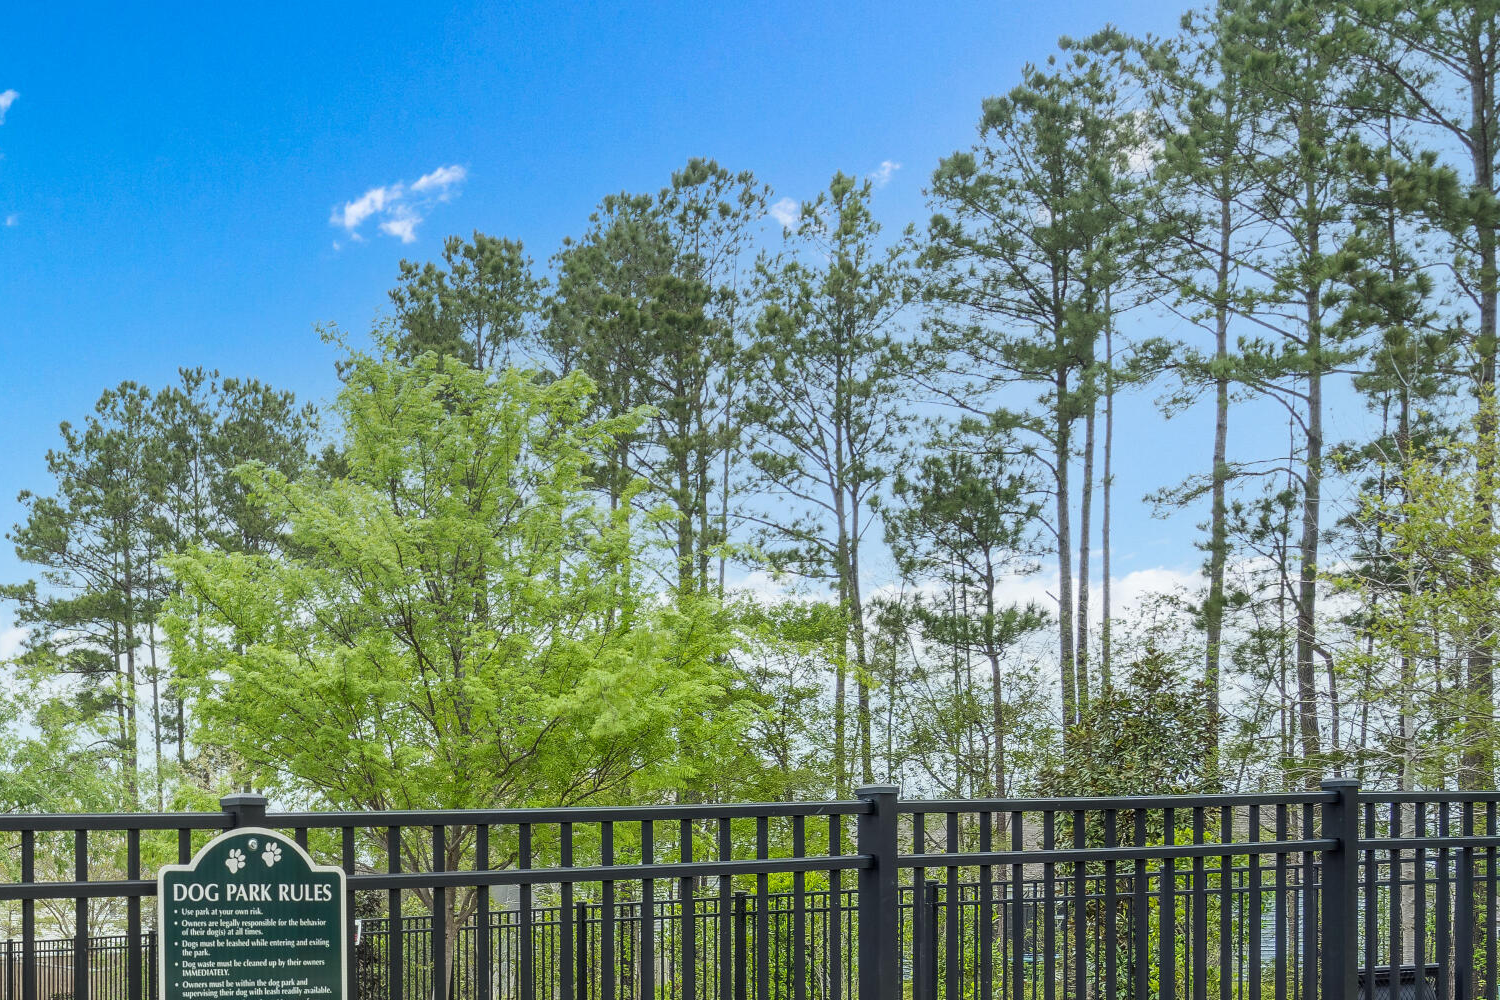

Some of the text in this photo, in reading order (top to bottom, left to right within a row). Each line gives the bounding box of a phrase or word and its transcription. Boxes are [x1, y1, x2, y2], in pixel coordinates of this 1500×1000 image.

[173, 883, 332, 902] DOG PARK RULES
[182, 908, 195, 916] Use
[195, 908, 210, 918] park
[220, 919, 241, 928] legally
[242, 919, 277, 928] responsible
[278, 919, 288, 927] for
[289, 918, 299, 927] the
[207, 928, 226, 938] dog(s)
[235, 928, 244, 936] all
[245, 928, 264, 936] times.
[182, 940, 199, 950] Dogs
[200, 940, 216, 948] must
[226, 939, 250, 947] leashed
[251, 939, 269, 947] while
[270, 939, 296, 948] entering
[296, 938, 308, 946] and
[309, 938, 330, 948] exiting
[182, 949, 211, 959] the park.
[182, 961, 197, 970] Dog
[217, 960, 233, 968] must
[243, 959, 268, 967] cleaned
[278, 959, 286, 968] by
[287, 958, 302, 966] their
[183, 969, 230, 977] IMMEDIATELY.
[182, 981, 208, 989] Owners
[226, 980, 234, 988] be
[235, 979, 256, 987] within
[257, 979, 267, 987] the
[268, 979, 281, 988] dog
[281, 978, 296, 988] park
[297, 978, 308, 986] and
[182, 986, 332, 1000] supervising their dog with leash readily available.
